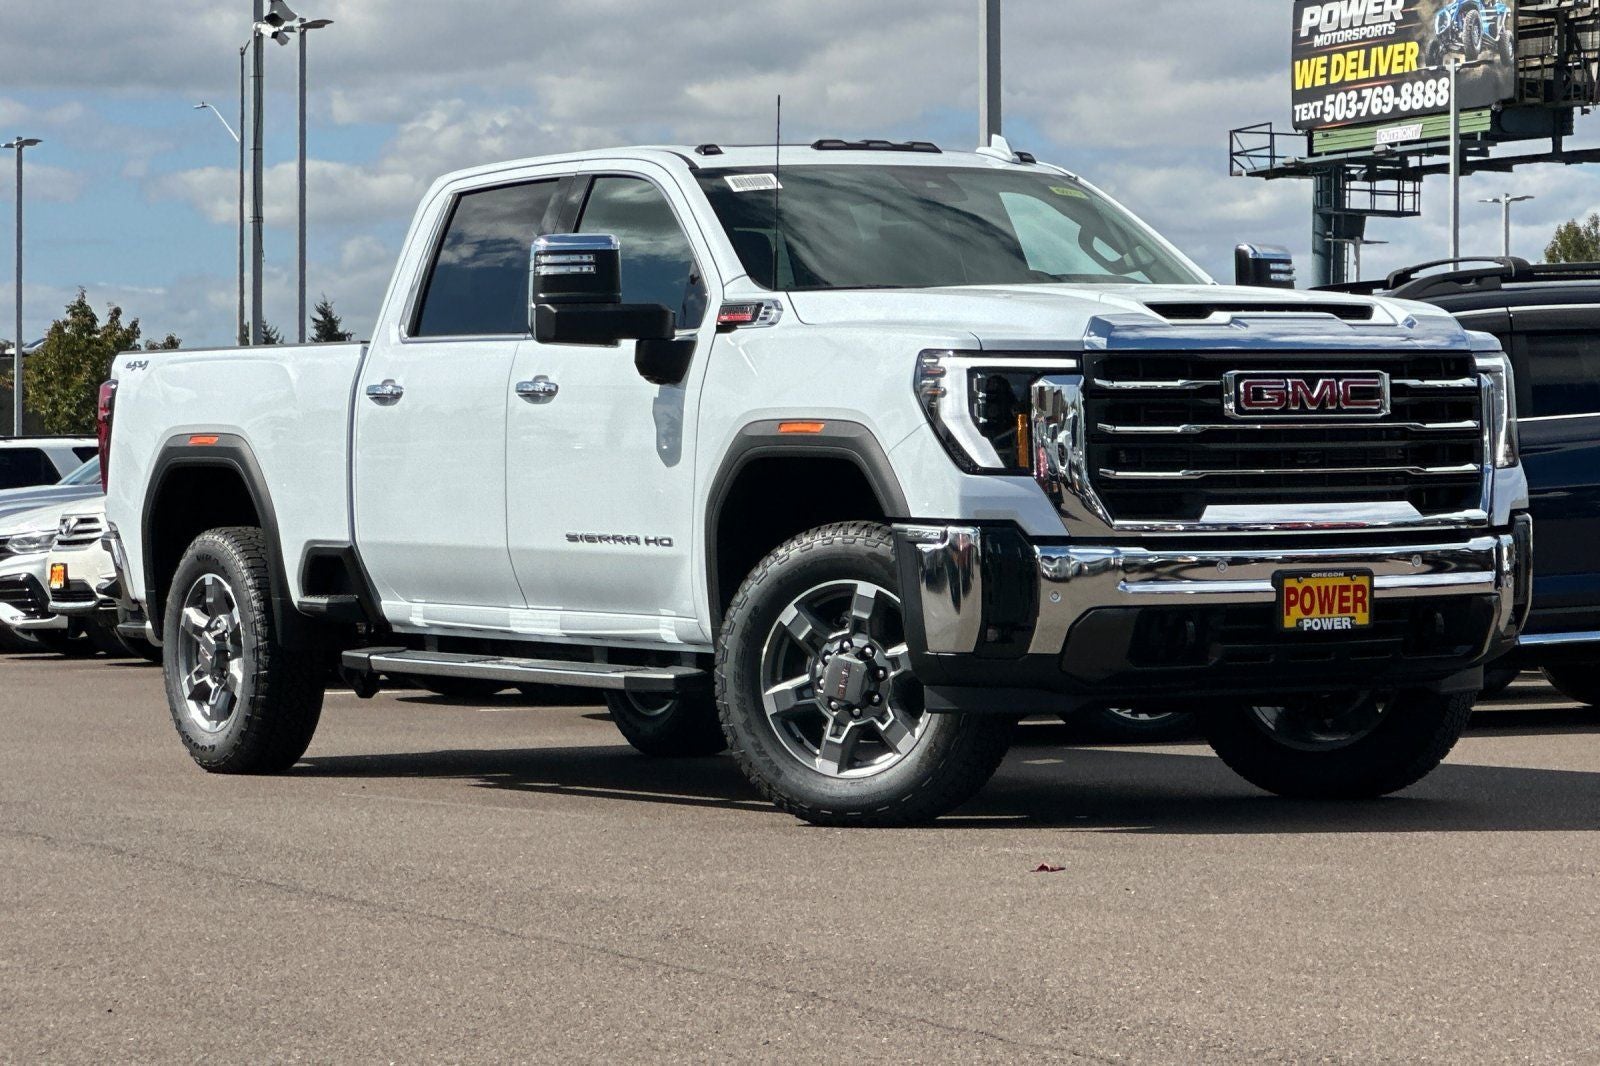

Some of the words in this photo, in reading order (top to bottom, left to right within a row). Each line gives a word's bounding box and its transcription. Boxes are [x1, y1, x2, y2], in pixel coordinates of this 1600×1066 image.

[1300, 0, 1405, 37] POWER
[1313, 22, 1396, 47] MOTORSPORTS
[1294, 57, 1328, 90] WE
[1329, 41, 1419, 84] DELIVER
[1294, 100, 1323, 122] TEXT
[1323, 77, 1449, 122] 503-769-8888
[1240, 378, 1381, 410] GMC
[565, 532, 641, 545] SIERRA
[644, 536, 674, 547] HD
[1285, 584, 1368, 616] POWER
[1303, 617, 1352, 631] POWER
